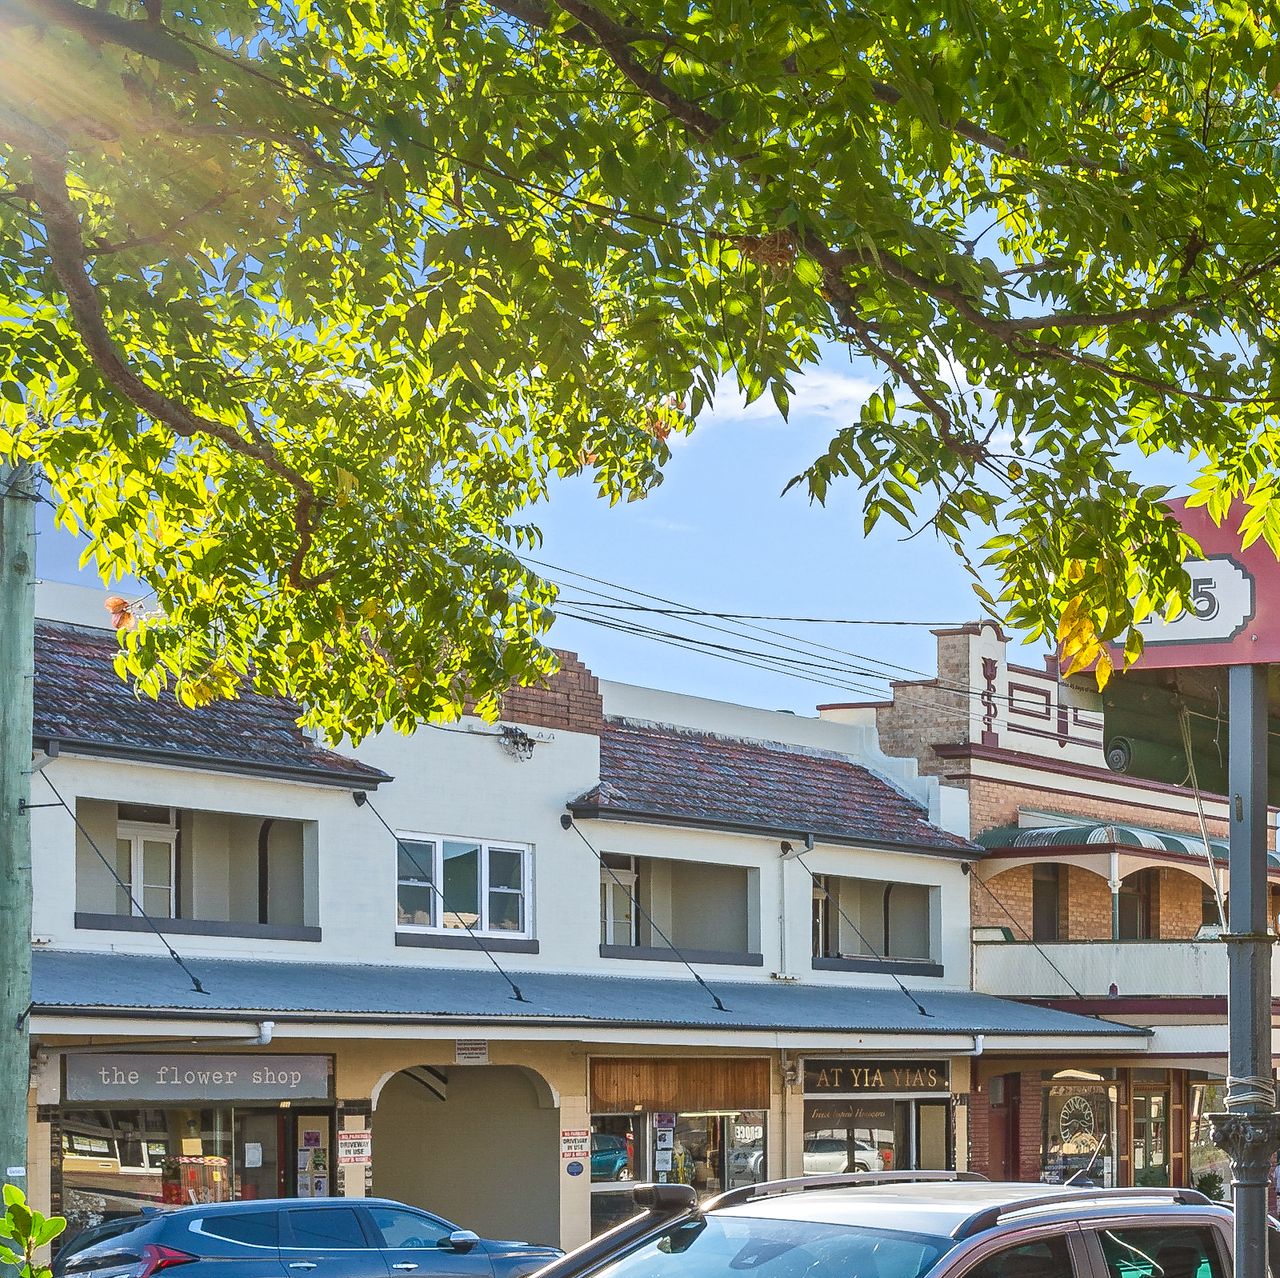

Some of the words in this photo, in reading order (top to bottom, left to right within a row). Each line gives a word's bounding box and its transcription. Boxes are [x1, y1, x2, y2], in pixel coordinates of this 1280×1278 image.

[98, 1066, 140, 1084] the
[155, 1066, 238, 1084] flower
[252, 1067, 302, 1088] shop
[816, 1068, 842, 1087] AT
[851, 1068, 884, 1087] YIA
[893, 1067, 937, 1087] YIA'S
